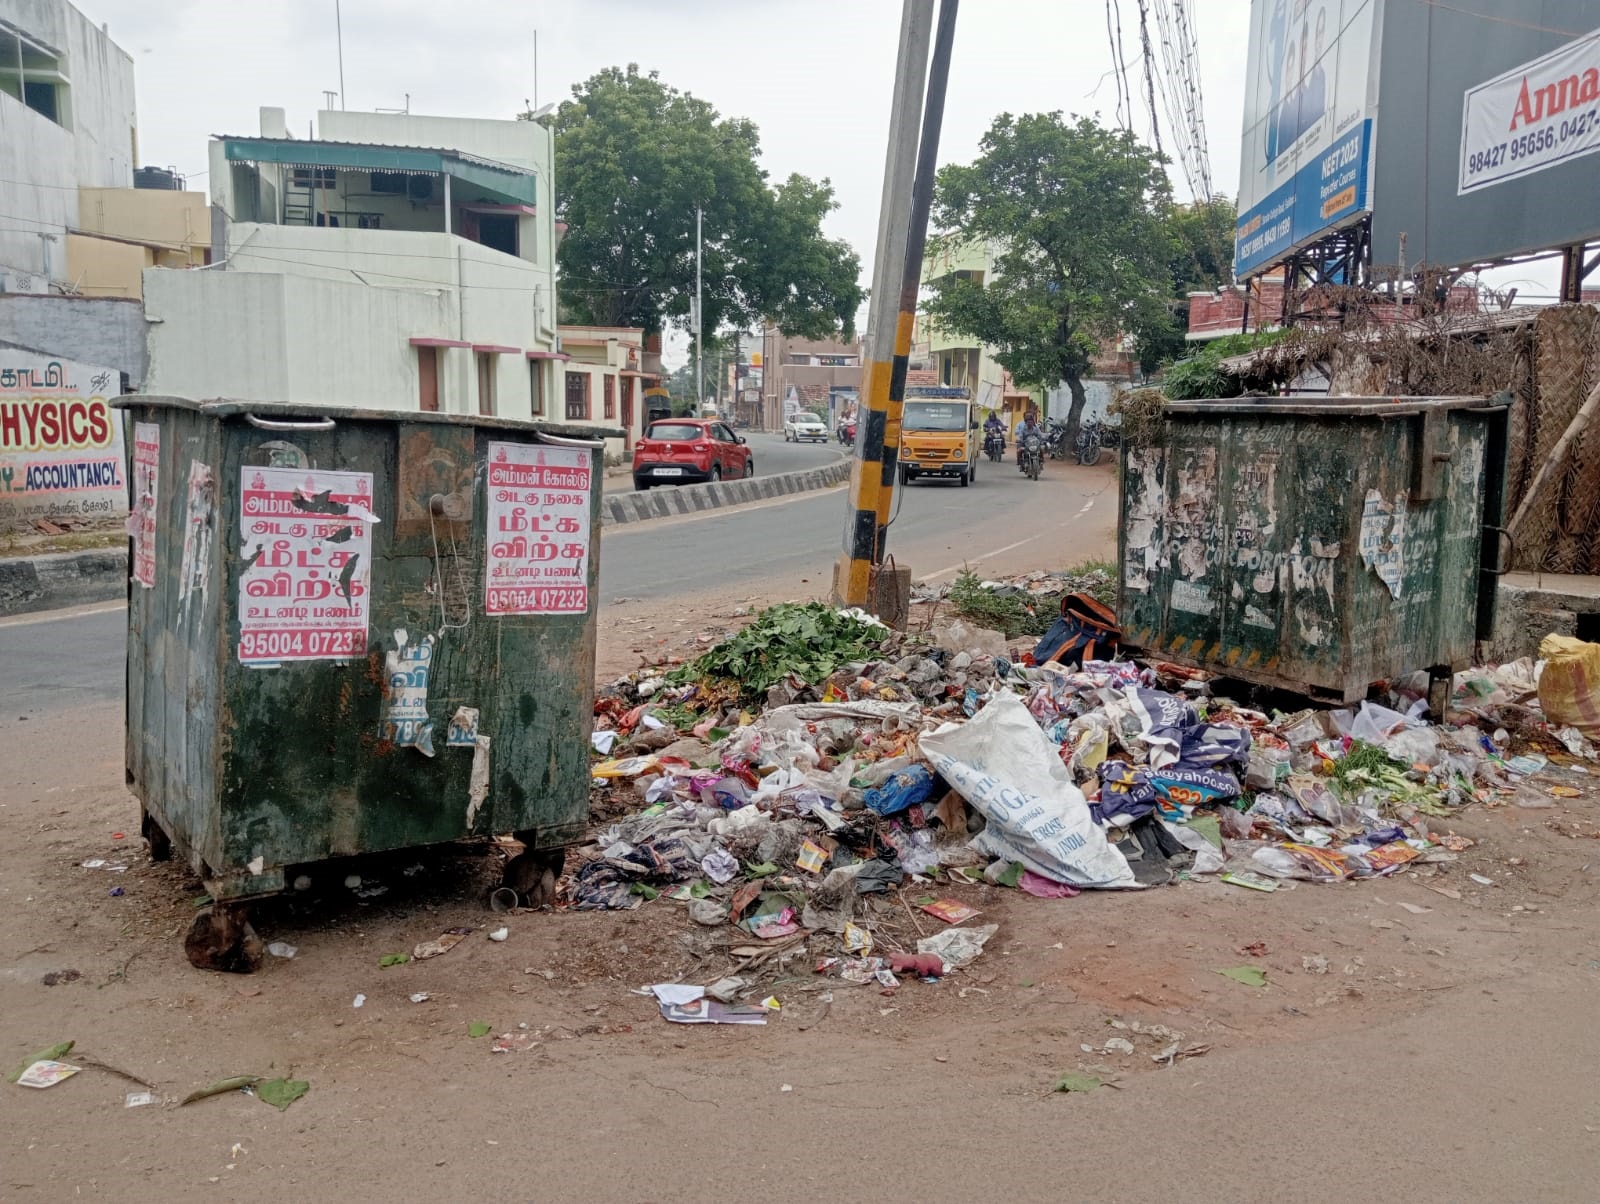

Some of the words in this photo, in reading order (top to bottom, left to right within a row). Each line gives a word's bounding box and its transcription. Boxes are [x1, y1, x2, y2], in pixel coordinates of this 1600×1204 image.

[1509, 67, 1600, 132] Anna
[1322, 149, 1340, 180] NEET
[1340, 136, 1359, 168] 2023
[1469, 143, 1507, 174] 98427
[0, 402, 108, 446] HYSICS
[491, 465, 539, 485] அம்மன்
[543, 468, 588, 489] கோல்டு
[496, 490, 539, 505] அடகு
[543, 493, 583, 506] நகை
[251, 521, 307, 537] அடகு
[499, 508, 580, 533] மீட்க
[491, 535, 585, 565] விற்க
[492, 567, 540, 579] உடனடி
[246, 571, 365, 603] விற்க
[489, 589, 537, 609] 95004
[541, 589, 584, 608] 07232
[248, 606, 308, 620] உடனடி
[313, 602, 362, 619] பணம்
[243, 632, 303, 655] 95004
[309, 631, 364, 652] 07232
